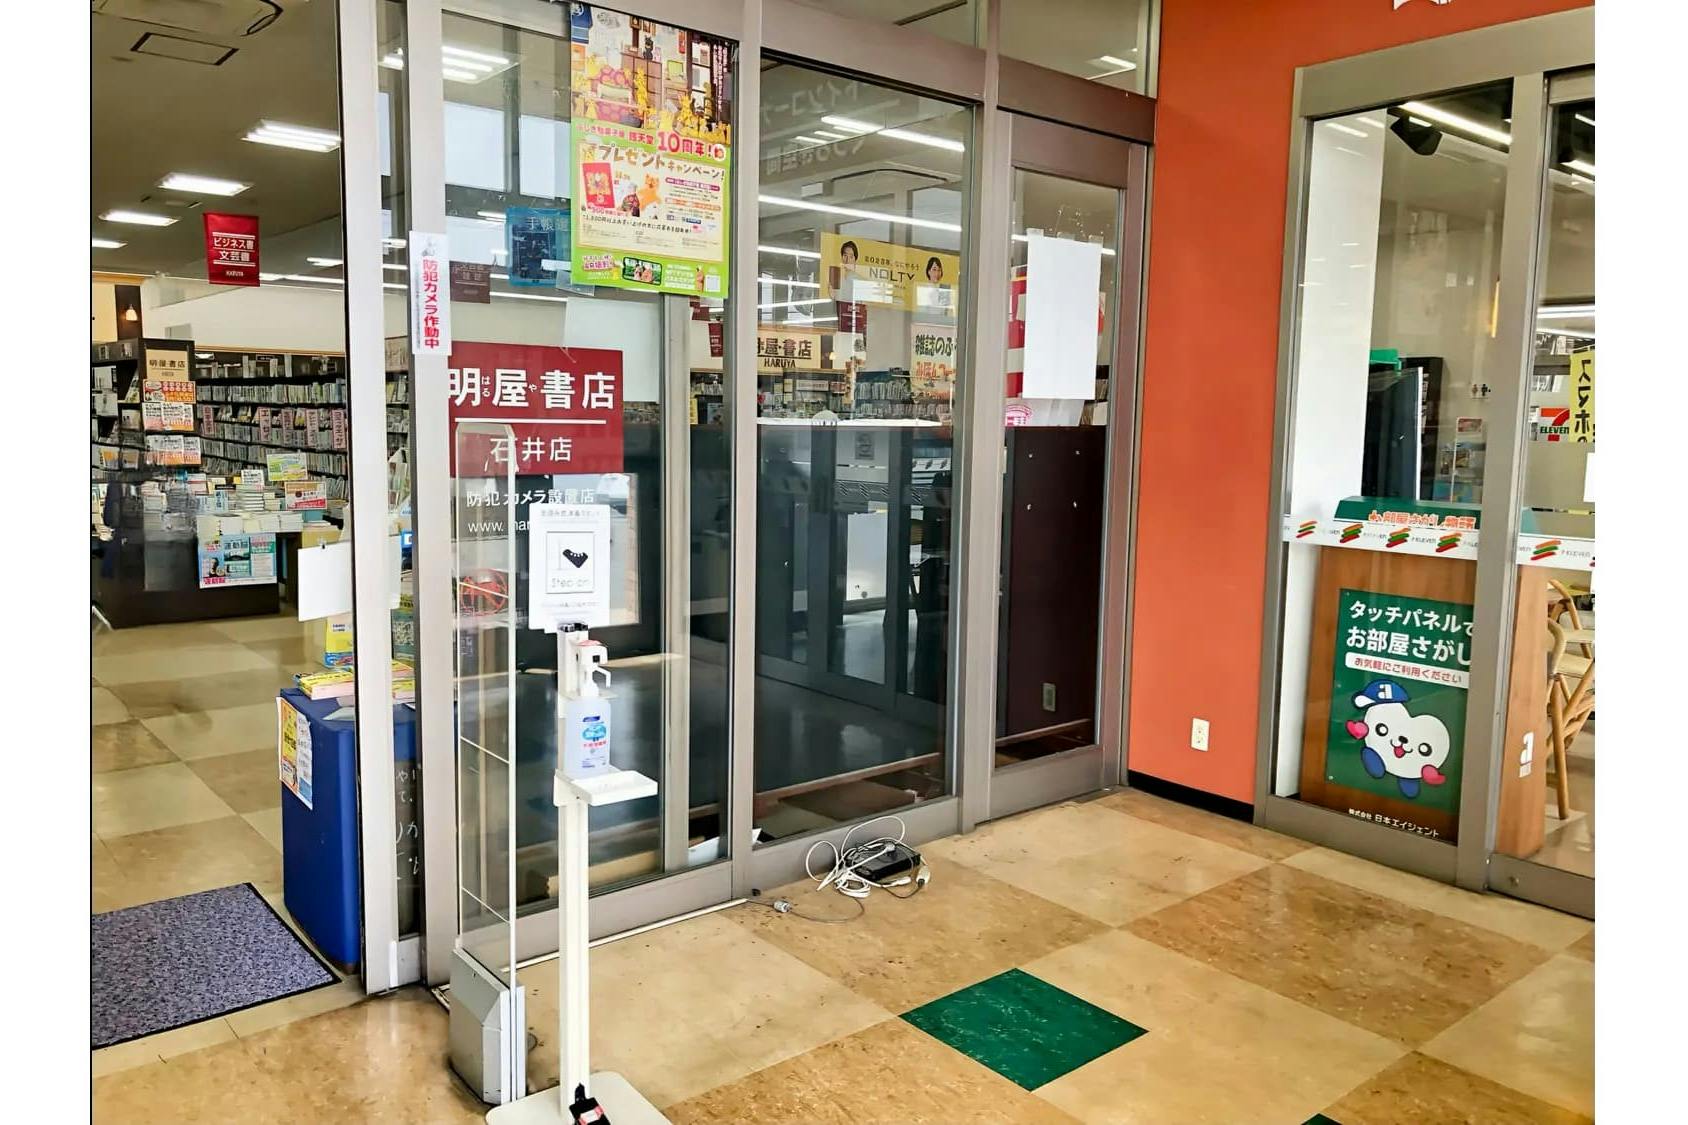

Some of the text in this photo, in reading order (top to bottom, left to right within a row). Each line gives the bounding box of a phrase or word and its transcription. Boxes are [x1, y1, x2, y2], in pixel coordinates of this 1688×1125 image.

[869, 267, 916, 283] NOLTY
[423, 258, 440, 349] 防犯カメラ作動中
[764, 358, 796, 368] HARUYA
[490, 436, 573, 462] 石井店
[1346, 626, 1472, 666] お部屋さがし
[1354, 657, 1462, 683] お気軽にご利用ください
[1348, 808, 1439, 838] 株式会社 日本エイジェント
